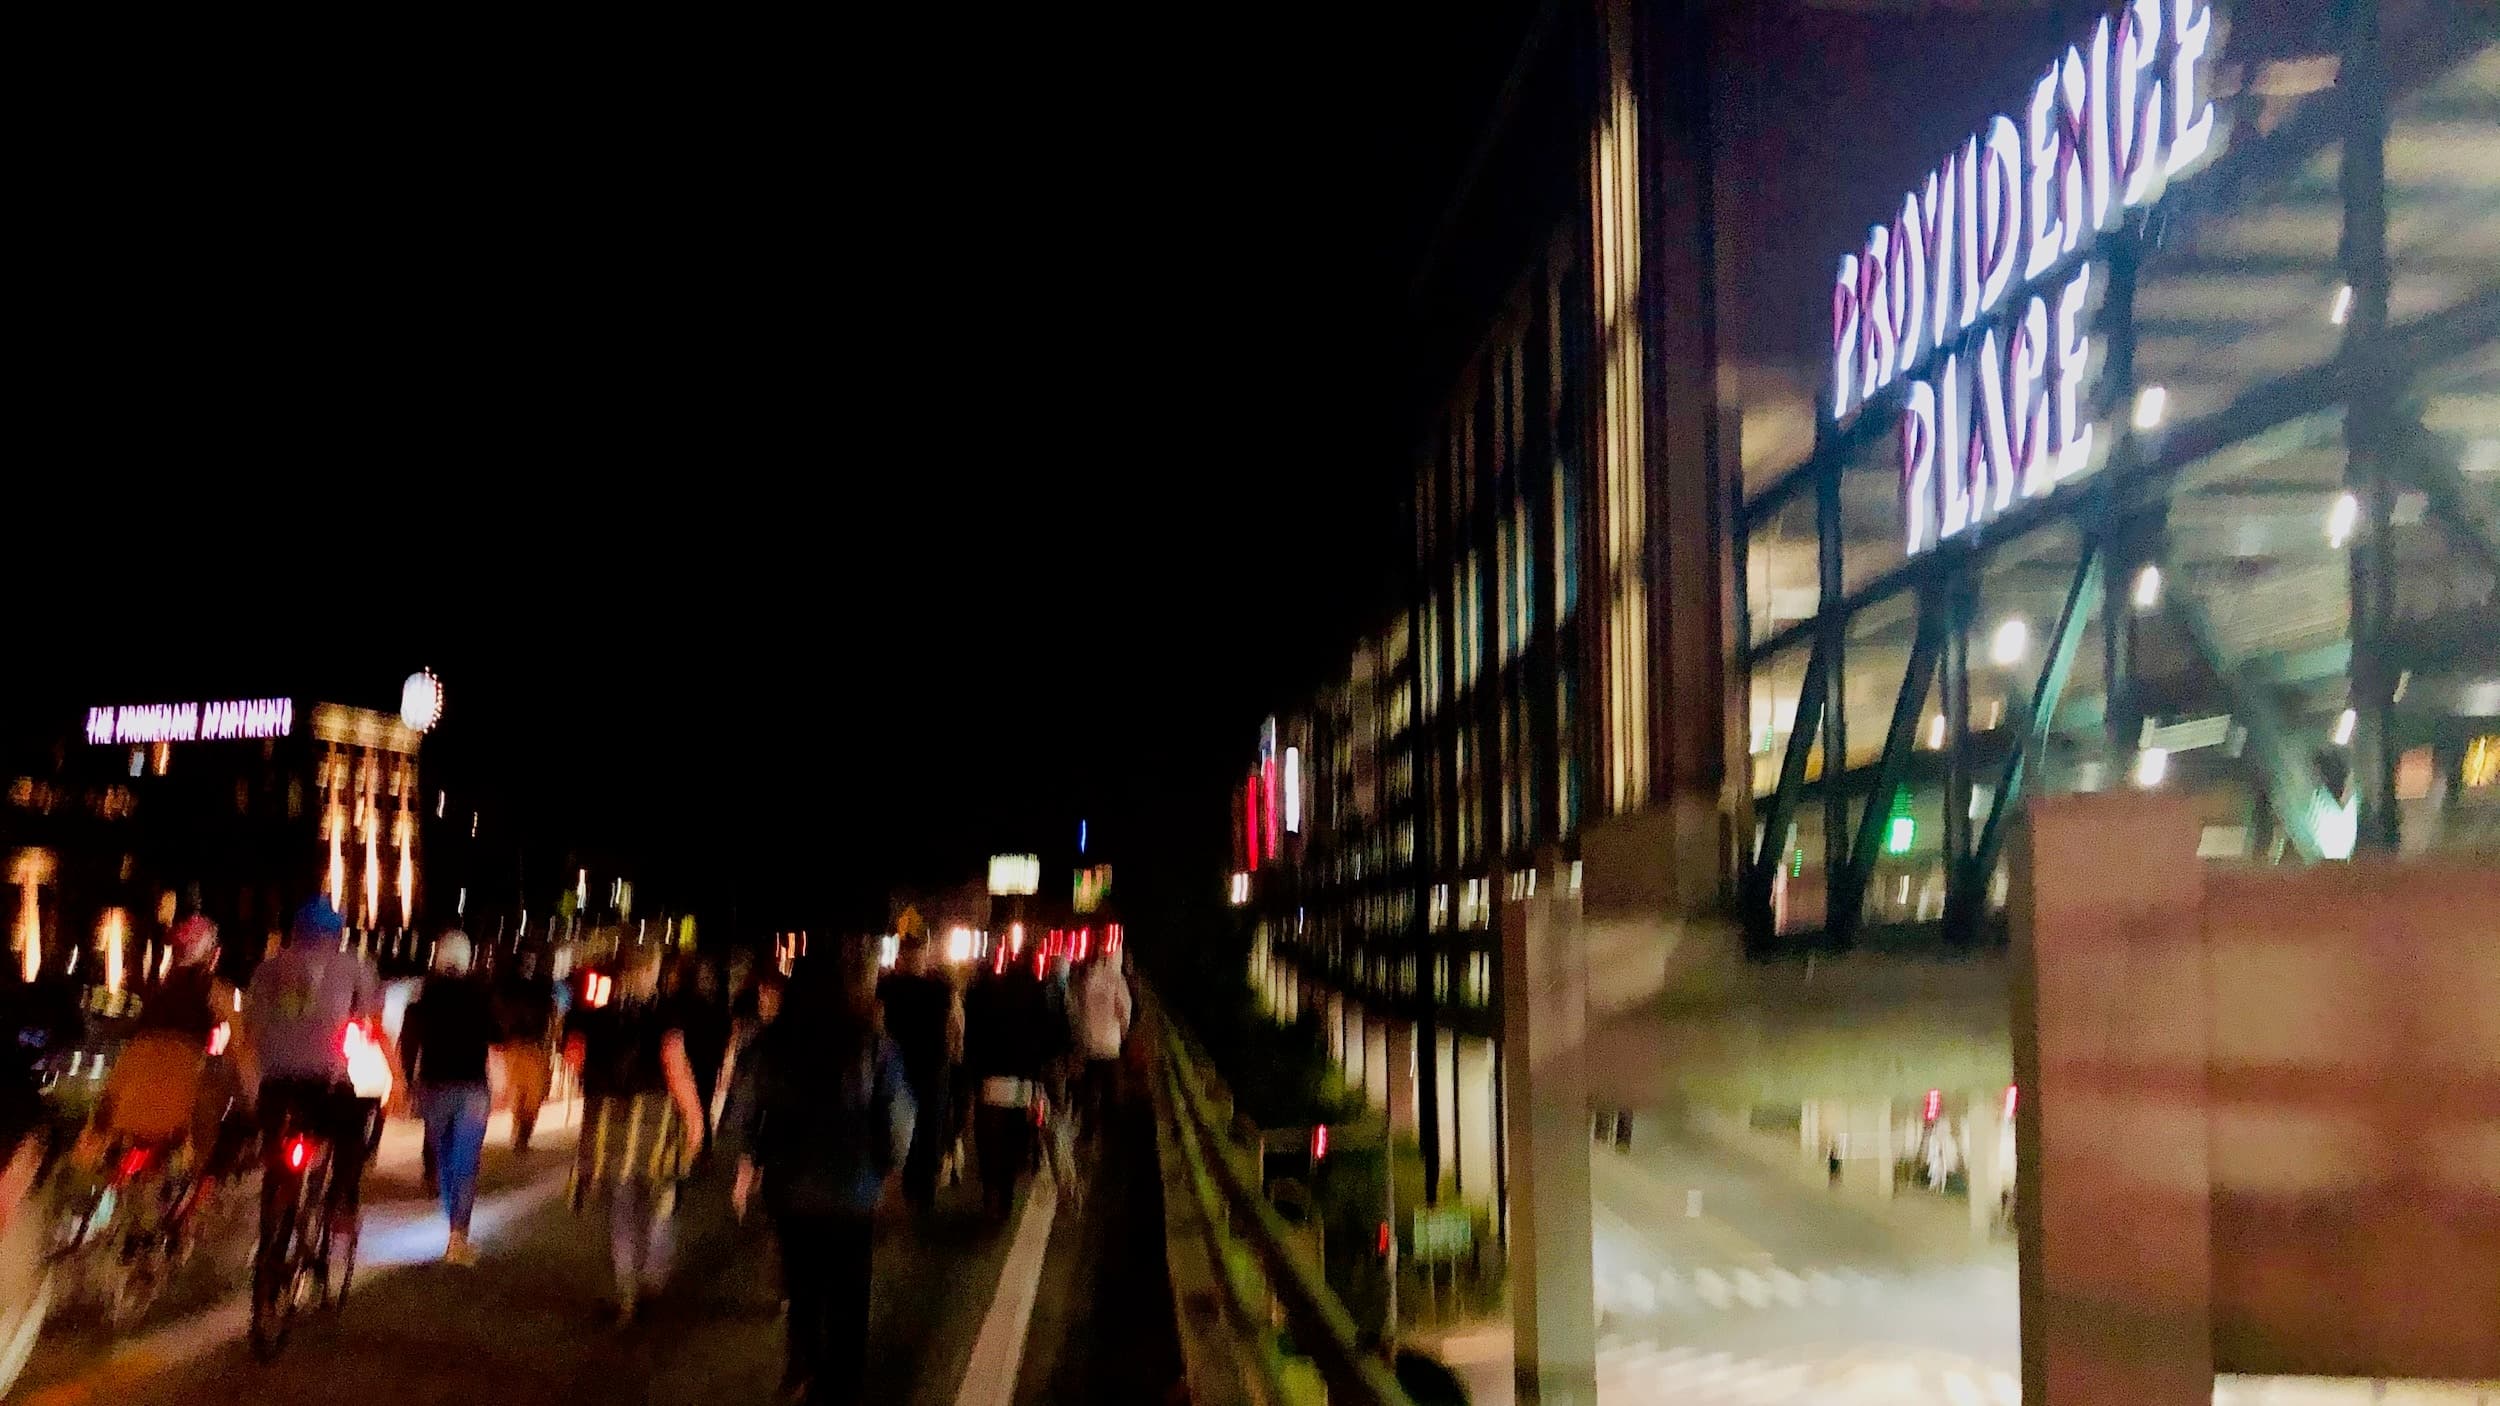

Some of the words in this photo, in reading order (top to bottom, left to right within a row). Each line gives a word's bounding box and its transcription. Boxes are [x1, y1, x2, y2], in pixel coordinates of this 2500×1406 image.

[1833, 0, 2214, 419] PROVIDENCE
[1903, 262, 2093, 555] PLACE
[87, 706, 115, 745] THE
[116, 702, 198, 745] PROMENADE
[201, 697, 292, 740] APARTMENTS
